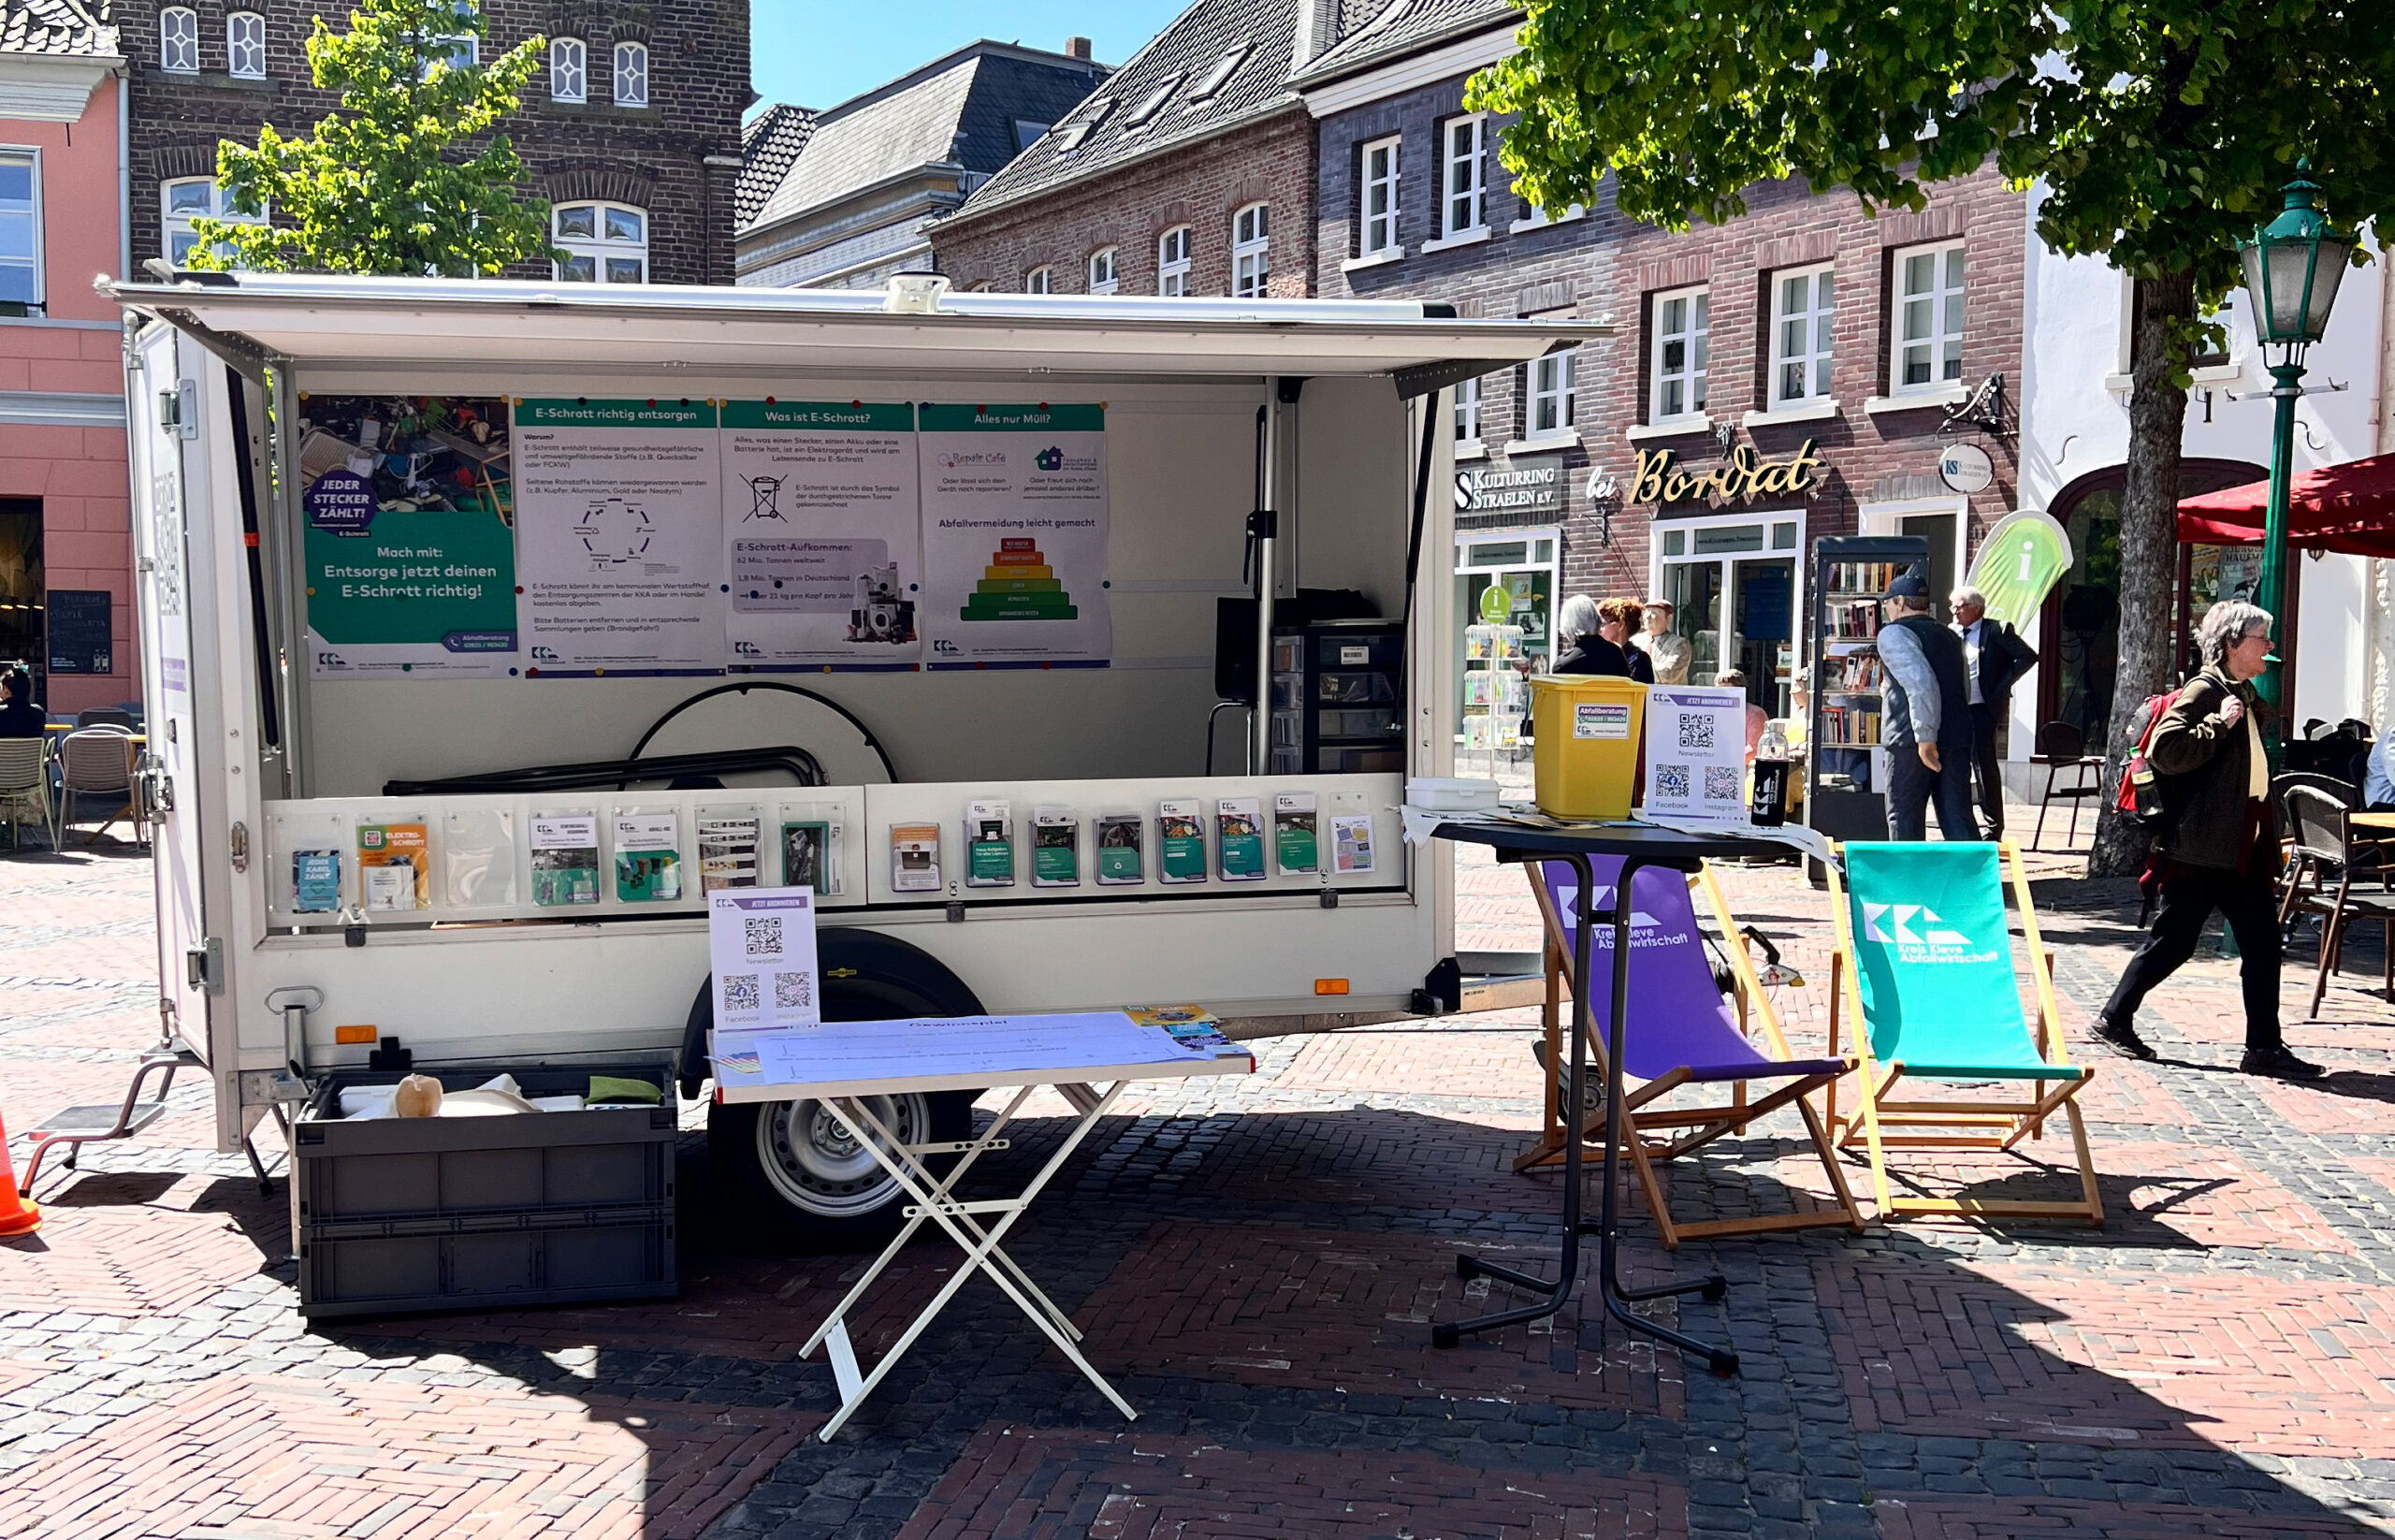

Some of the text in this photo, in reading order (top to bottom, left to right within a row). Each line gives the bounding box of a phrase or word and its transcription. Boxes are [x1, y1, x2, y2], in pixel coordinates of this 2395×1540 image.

[536, 409, 696, 421] E-Schrott richtig entsorgen
[765, 412, 870, 423] Was ist E-Schrott?
[974, 414, 1051, 424] Alles nur Müll?
[1627, 438, 1823, 503] Bordat
[322, 480, 359, 490] JEDER
[1585, 467, 1616, 500] bei
[313, 494, 369, 504] STECKER
[319, 506, 365, 518] ZÄHLT!
[939, 519, 1023, 529] Abfallvermeidung
[1055, 520, 1096, 529] gemacht
[377, 547, 443, 557] Mach mit:
[326, 565, 496, 580] Entsorge jetzt deinen
[426, 585, 482, 600] richtig!
[1594, 929, 1654, 939] Krei leve
[1599, 933, 1688, 949] Ablwirtschaft
[1898, 945, 1964, 954] Kreis Kleve
[1900, 952, 1997, 963] Abfallwirtschaft
